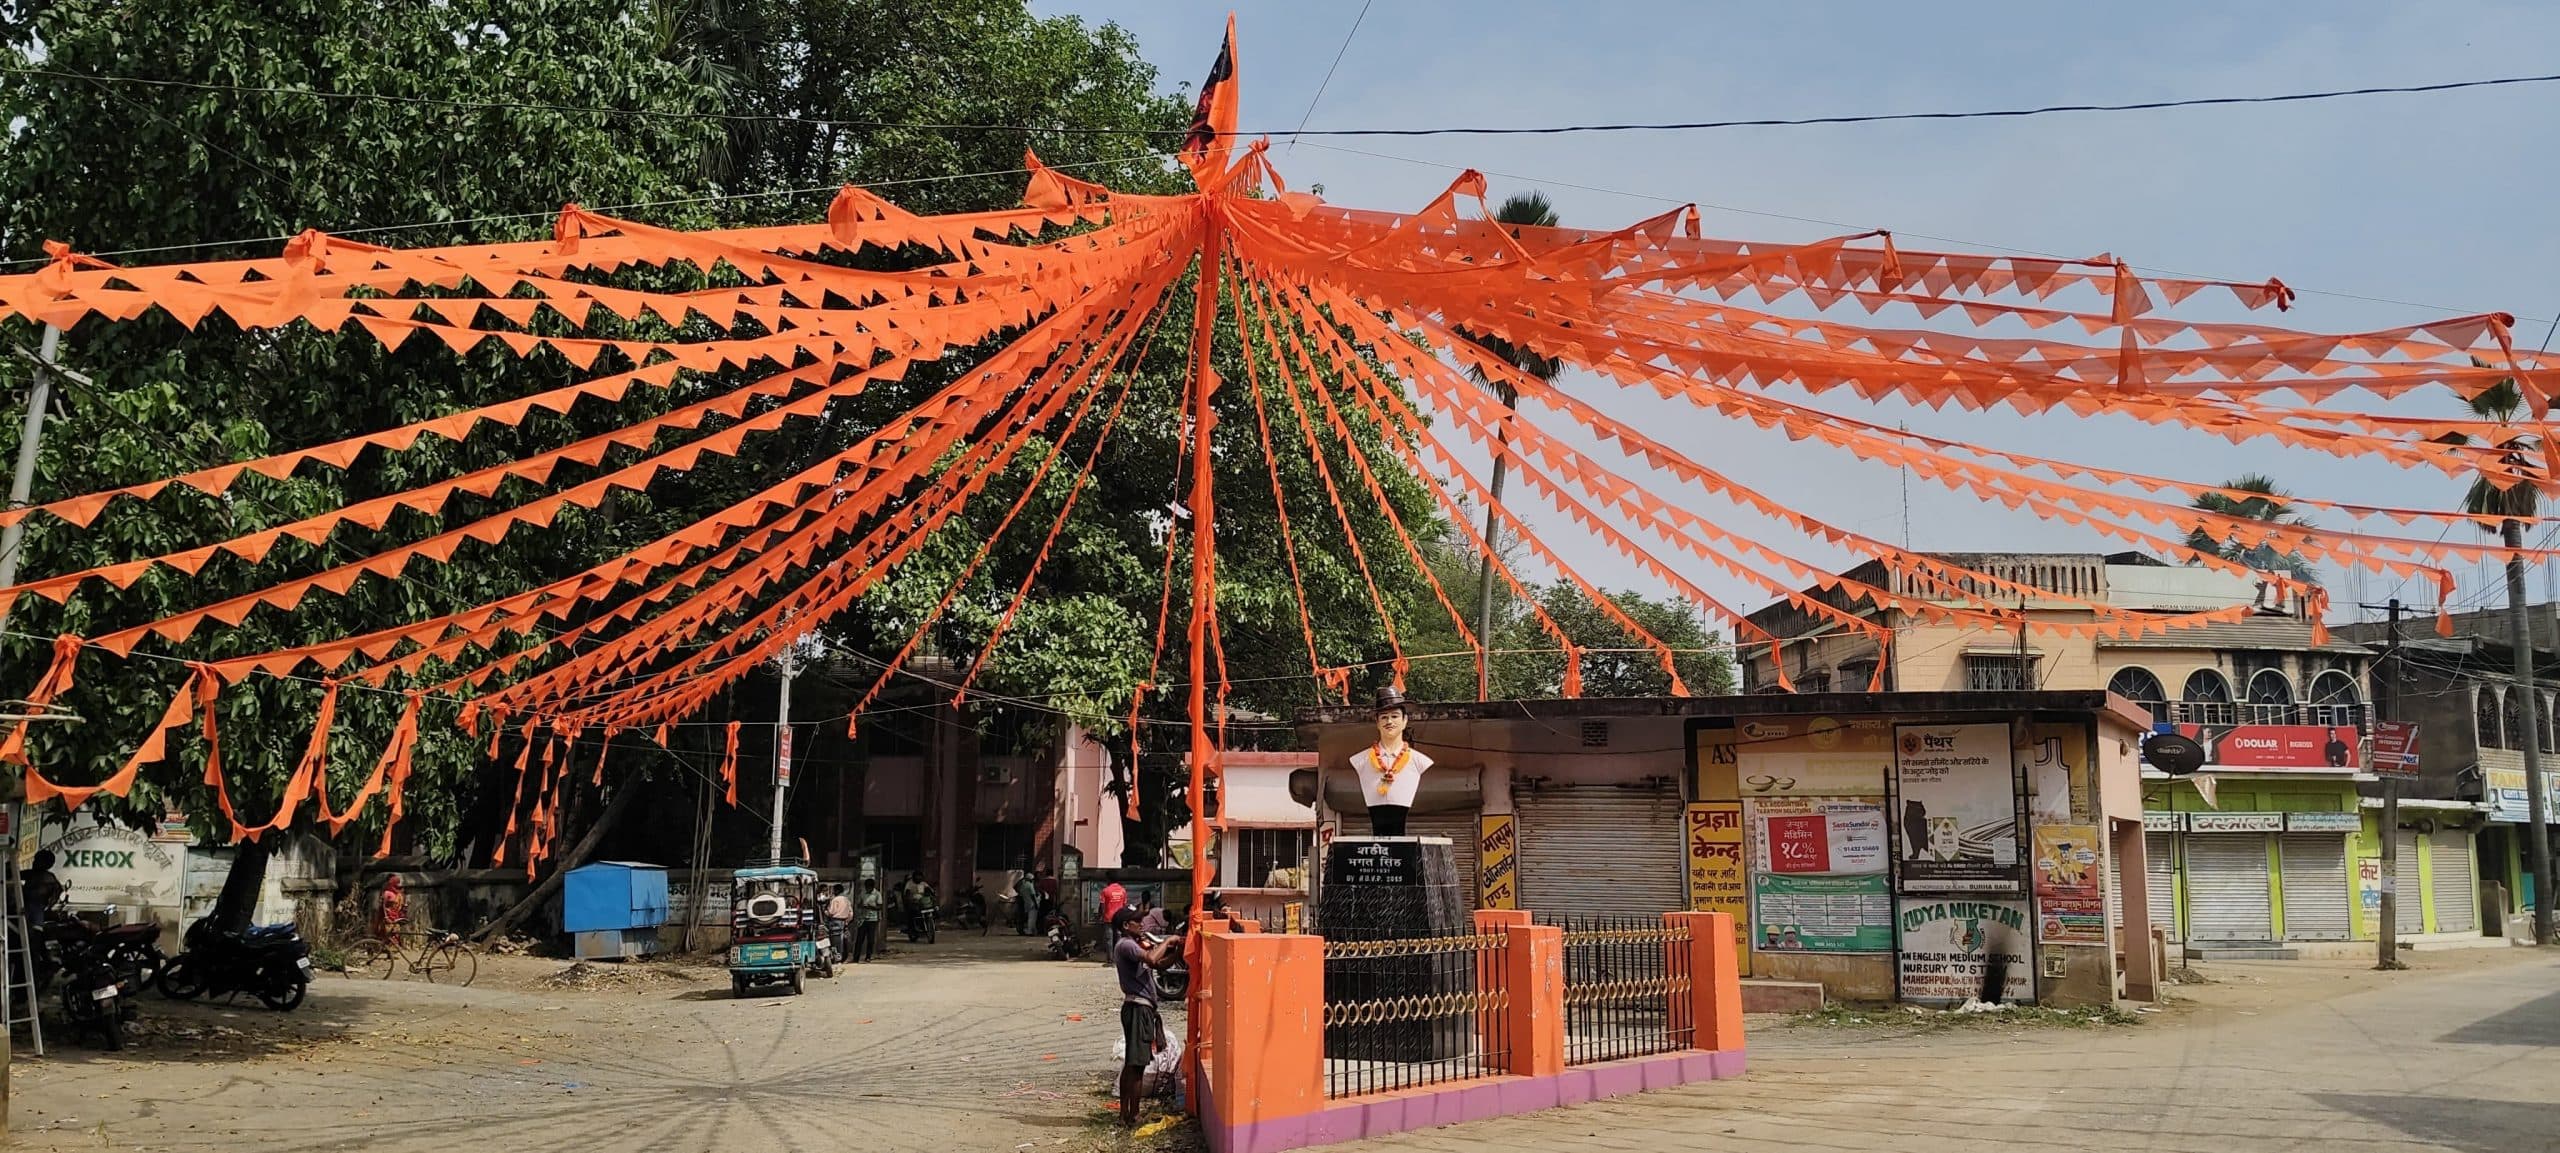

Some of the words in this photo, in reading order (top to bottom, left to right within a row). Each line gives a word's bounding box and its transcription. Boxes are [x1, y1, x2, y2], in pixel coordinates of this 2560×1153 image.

[1923, 733, 1954, 748] पैंथर
[2243, 739, 2278, 748] DOLLAR
[1690, 810, 1739, 833] प्रज्ञा
[1357, 843, 1389, 856] शहीद
[1691, 835, 1741, 865] केन्द्र
[63, 850, 136, 868] XEROX
[1348, 858, 1374, 867] भगत
[1379, 856, 1402, 867] सिंह
[1903, 903, 1947, 930] VIDYA
[1912, 952, 1946, 961] ENGLISH
[1949, 952, 1985, 962] MEDIUM
[1903, 964, 1948, 974] NURSURY
[1951, 964, 1965, 974] TO
